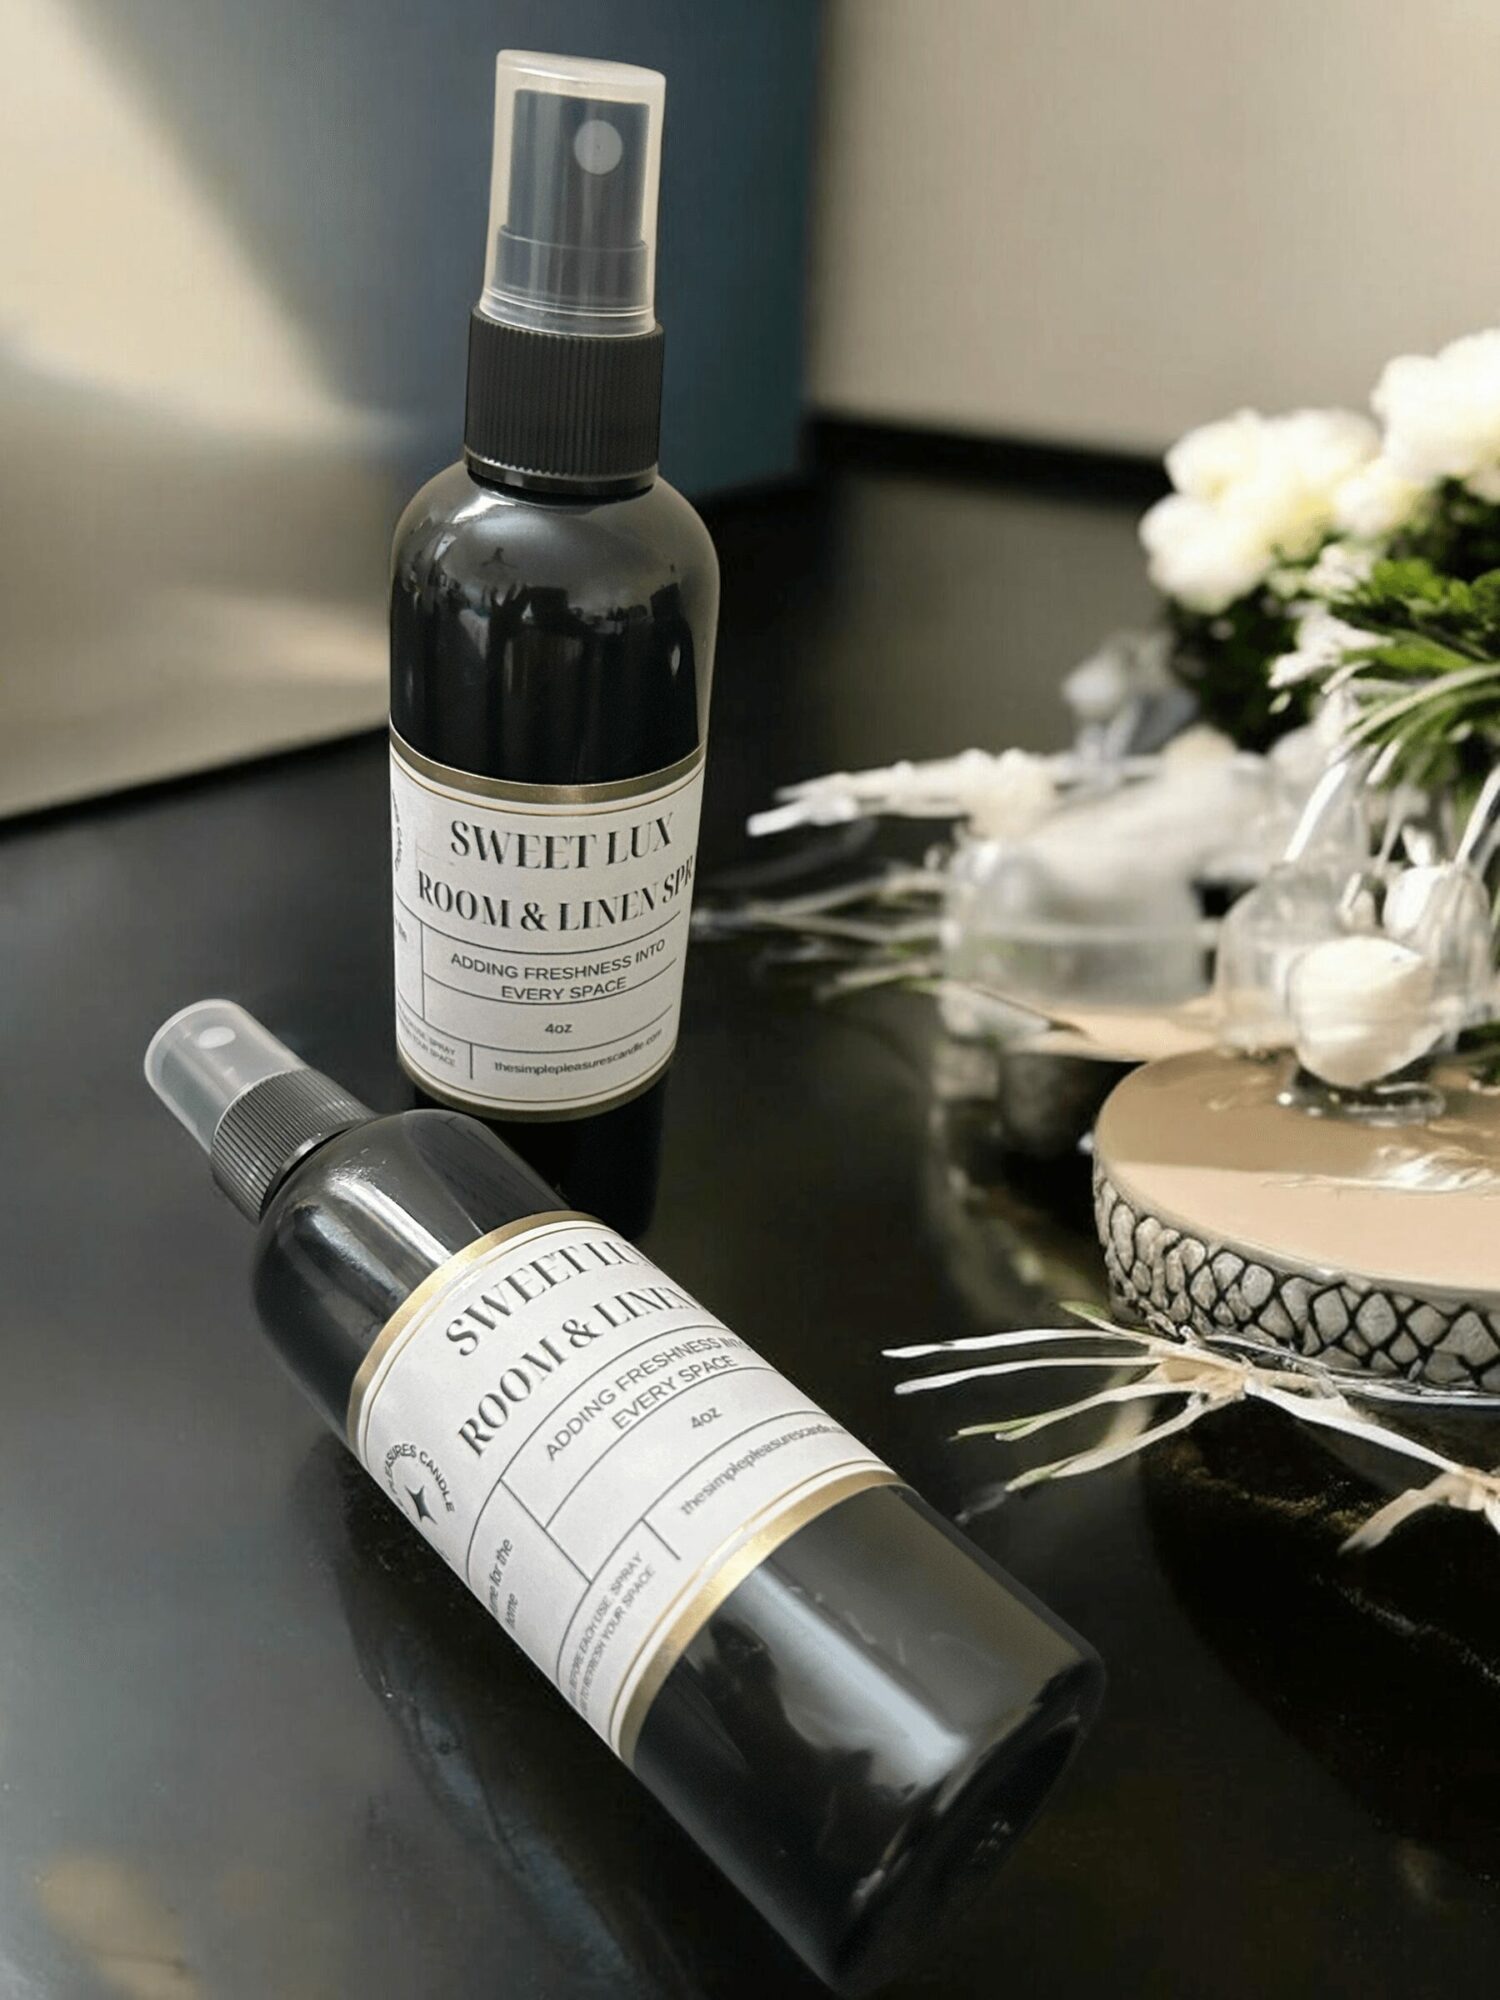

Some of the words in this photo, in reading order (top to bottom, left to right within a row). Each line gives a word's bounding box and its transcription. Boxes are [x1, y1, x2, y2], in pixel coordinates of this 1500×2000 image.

[450, 820, 598, 870] SWEET
[606, 811, 673, 866] LUX
[417, 869, 512, 930] ROOM
[520, 901, 549, 932] &
[558, 881, 660, 932] LINEN
[450, 952, 519, 980] ADDING
[524, 955, 632, 981] FRESHNESS
[635, 938, 666, 965] INTO
[501, 985, 566, 1001] EVERY
[570, 976, 627, 1000] SPACE
[494, 1027, 663, 1076] thesimplepleasurescandle.com
[544, 1022, 573, 1035] 4oz
[445, 1245, 591, 1357] SWEET
[457, 1335, 569, 1459] ROOM
[561, 1318, 605, 1349] &
[545, 1387, 618, 1462] ADDING
[615, 1336, 722, 1394] FRESHNESS
[610, 1375, 679, 1431] EVERY
[679, 1354, 739, 1385] SPACE
[690, 1406, 723, 1429] 4oz
[419, 1450, 455, 1513] CANDLE
[496, 1538, 513, 1567] the
[609, 1551, 642, 1596] SPRAY
[600, 1605, 626, 1640] YOUR
[620, 1562, 656, 1608] SPACE
